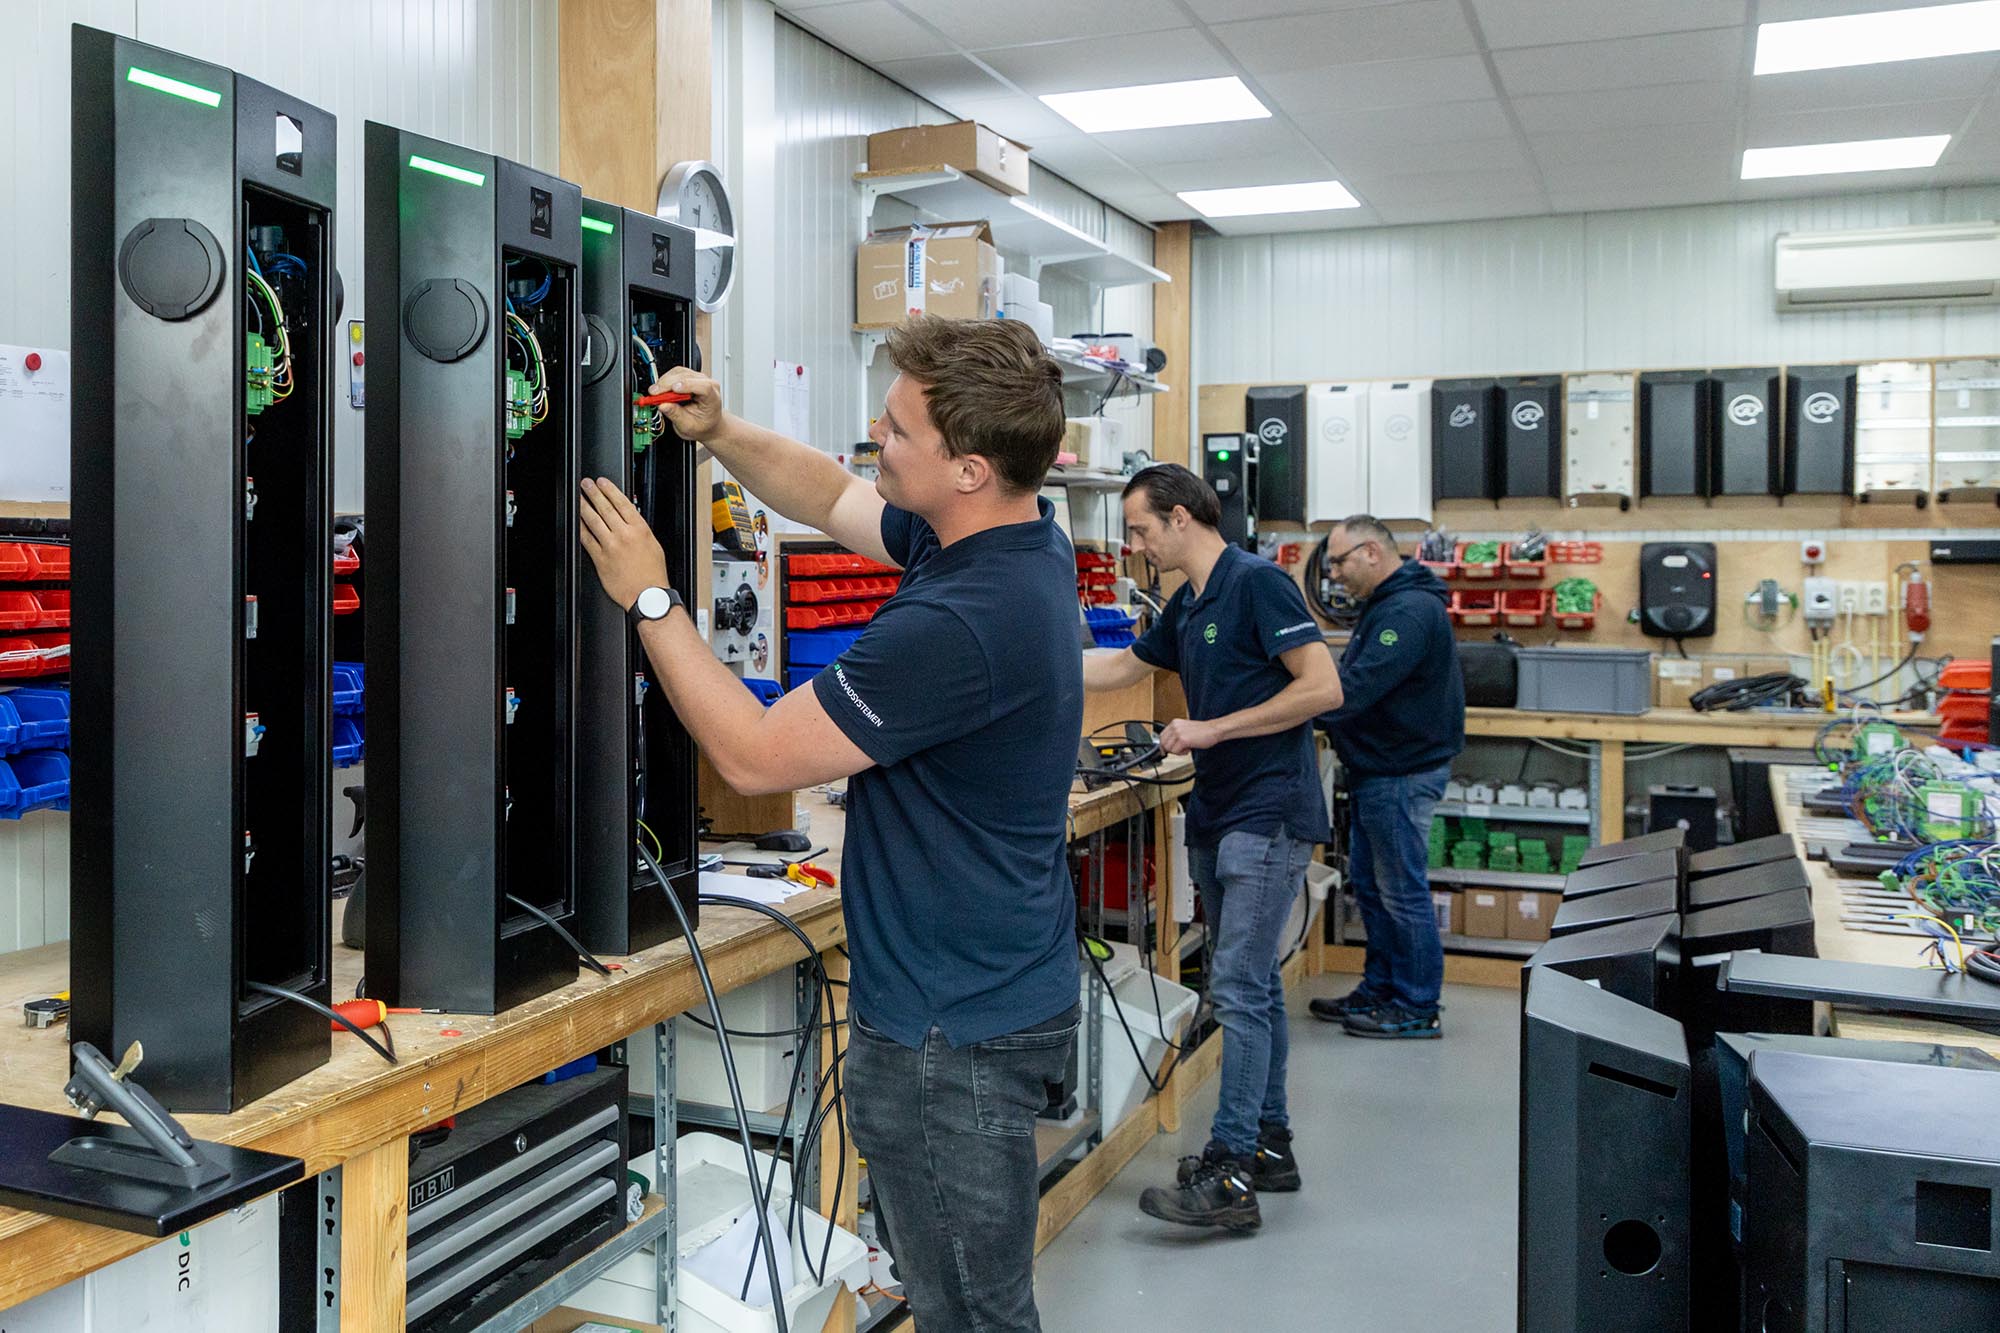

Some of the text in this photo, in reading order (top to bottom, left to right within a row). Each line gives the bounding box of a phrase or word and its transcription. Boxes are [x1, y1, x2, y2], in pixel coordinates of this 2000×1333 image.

[693, 181, 701, 197] 12
[712, 213, 718, 228] 2
[711, 265, 717, 279] 4
[703, 279, 709, 294] 5
[415, 1171, 451, 1204] HBM
[178, 1251, 190, 1292] DIC
